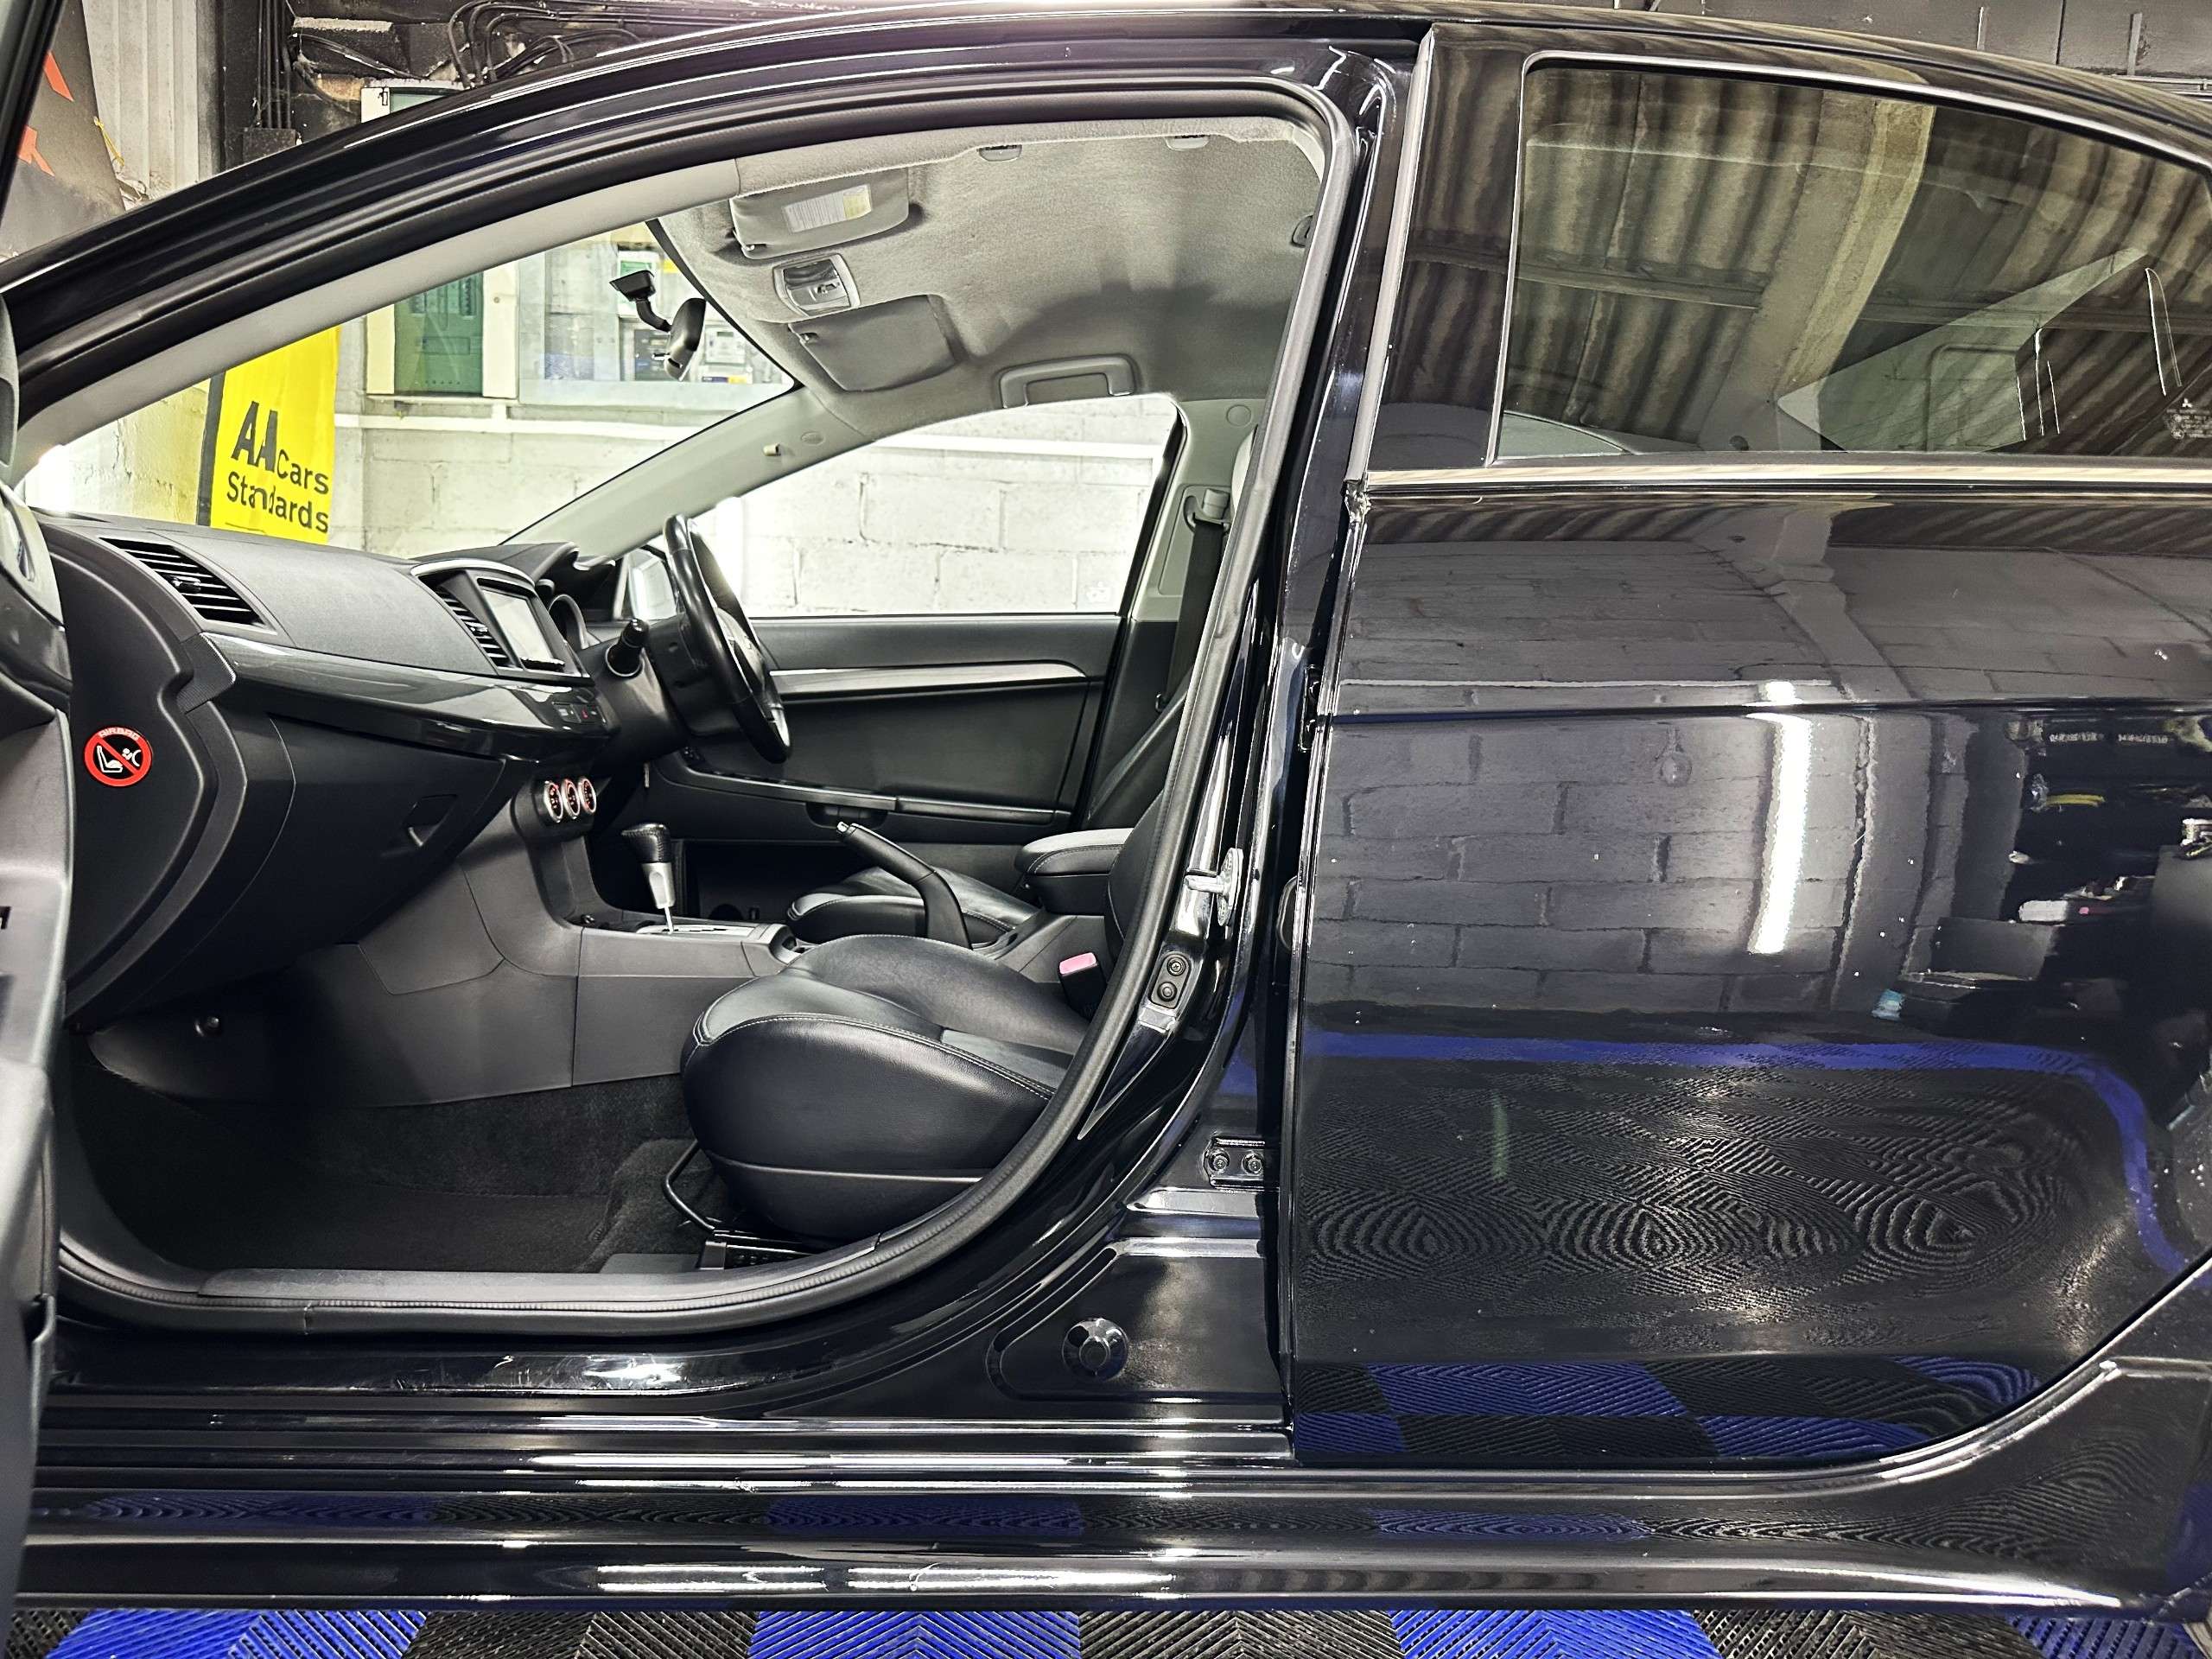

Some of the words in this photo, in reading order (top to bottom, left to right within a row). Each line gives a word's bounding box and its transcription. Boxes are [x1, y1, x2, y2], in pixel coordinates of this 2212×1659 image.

[231, 401, 278, 473] AA
[276, 448, 329, 495] Cars
[226, 471, 329, 533] Standards
[98, 727, 140, 741] AIRBAG
